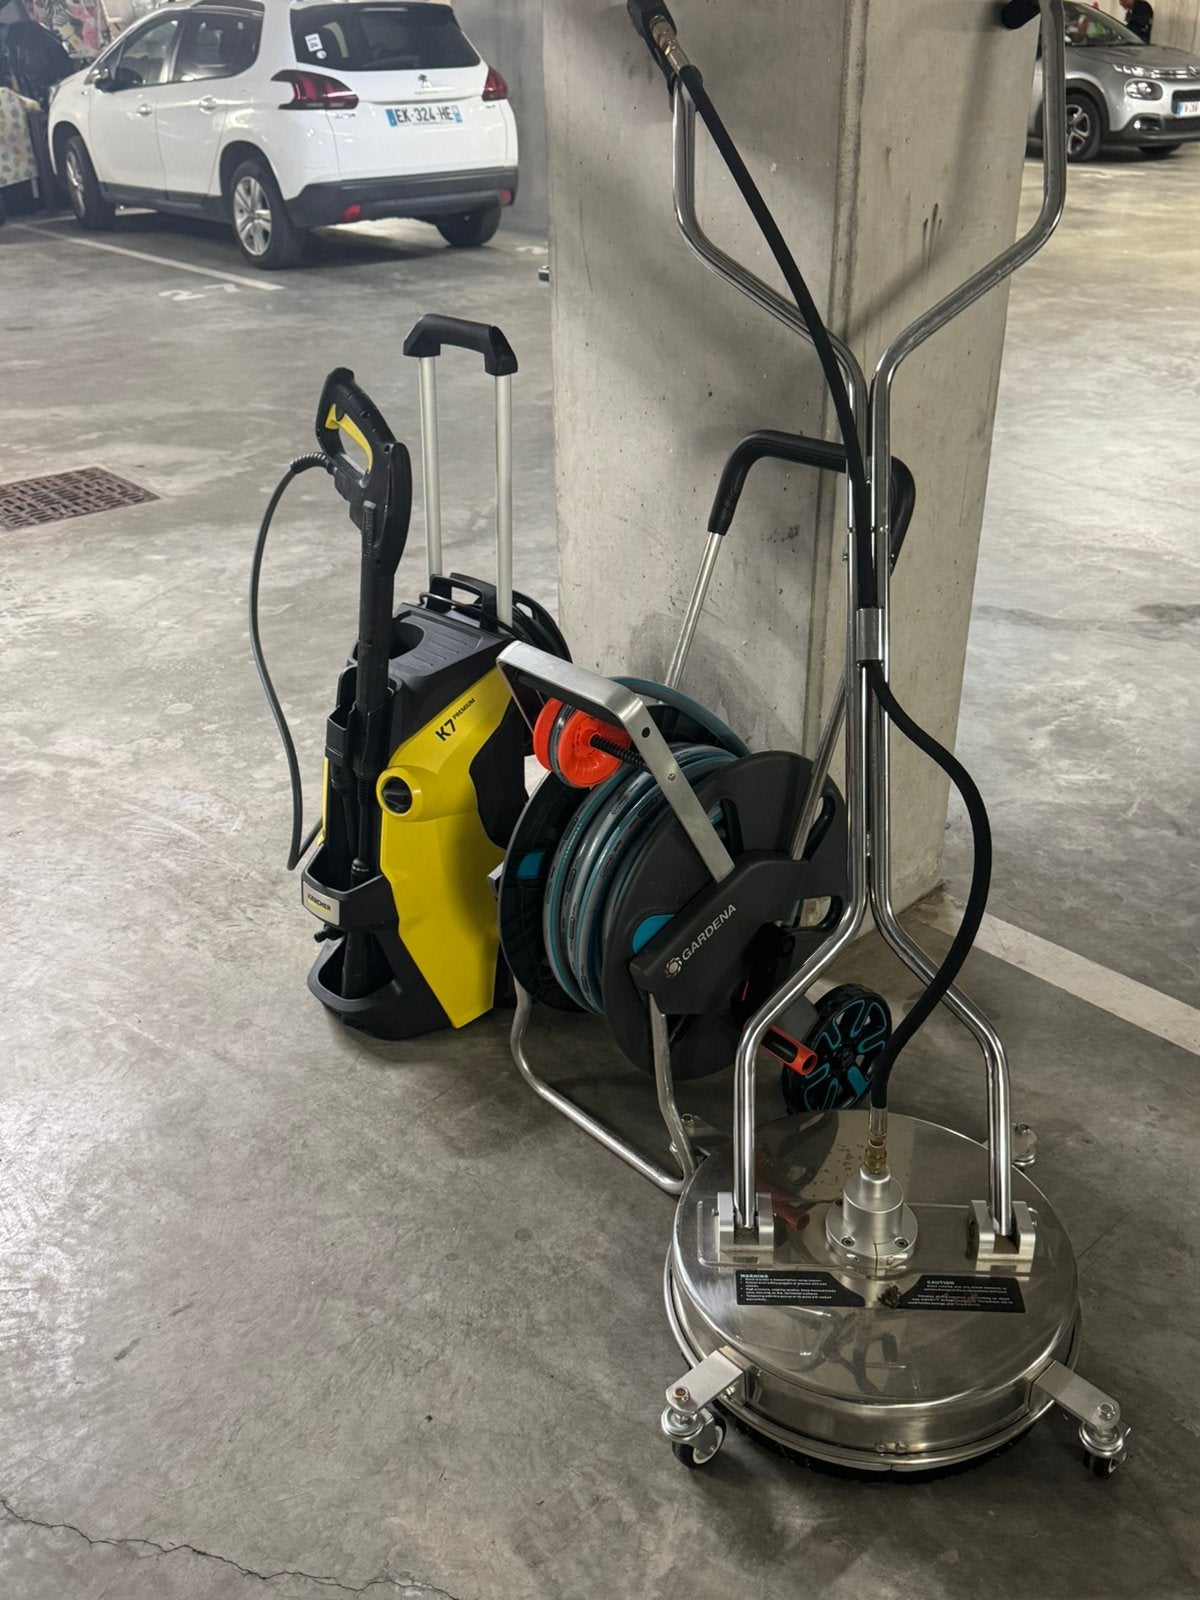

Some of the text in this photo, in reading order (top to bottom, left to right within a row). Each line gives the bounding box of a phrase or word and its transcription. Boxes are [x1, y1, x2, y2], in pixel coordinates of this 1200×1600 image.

[435, 698, 475, 741] K7 PREMIUM
[682, 904, 737, 961] GARDENA
